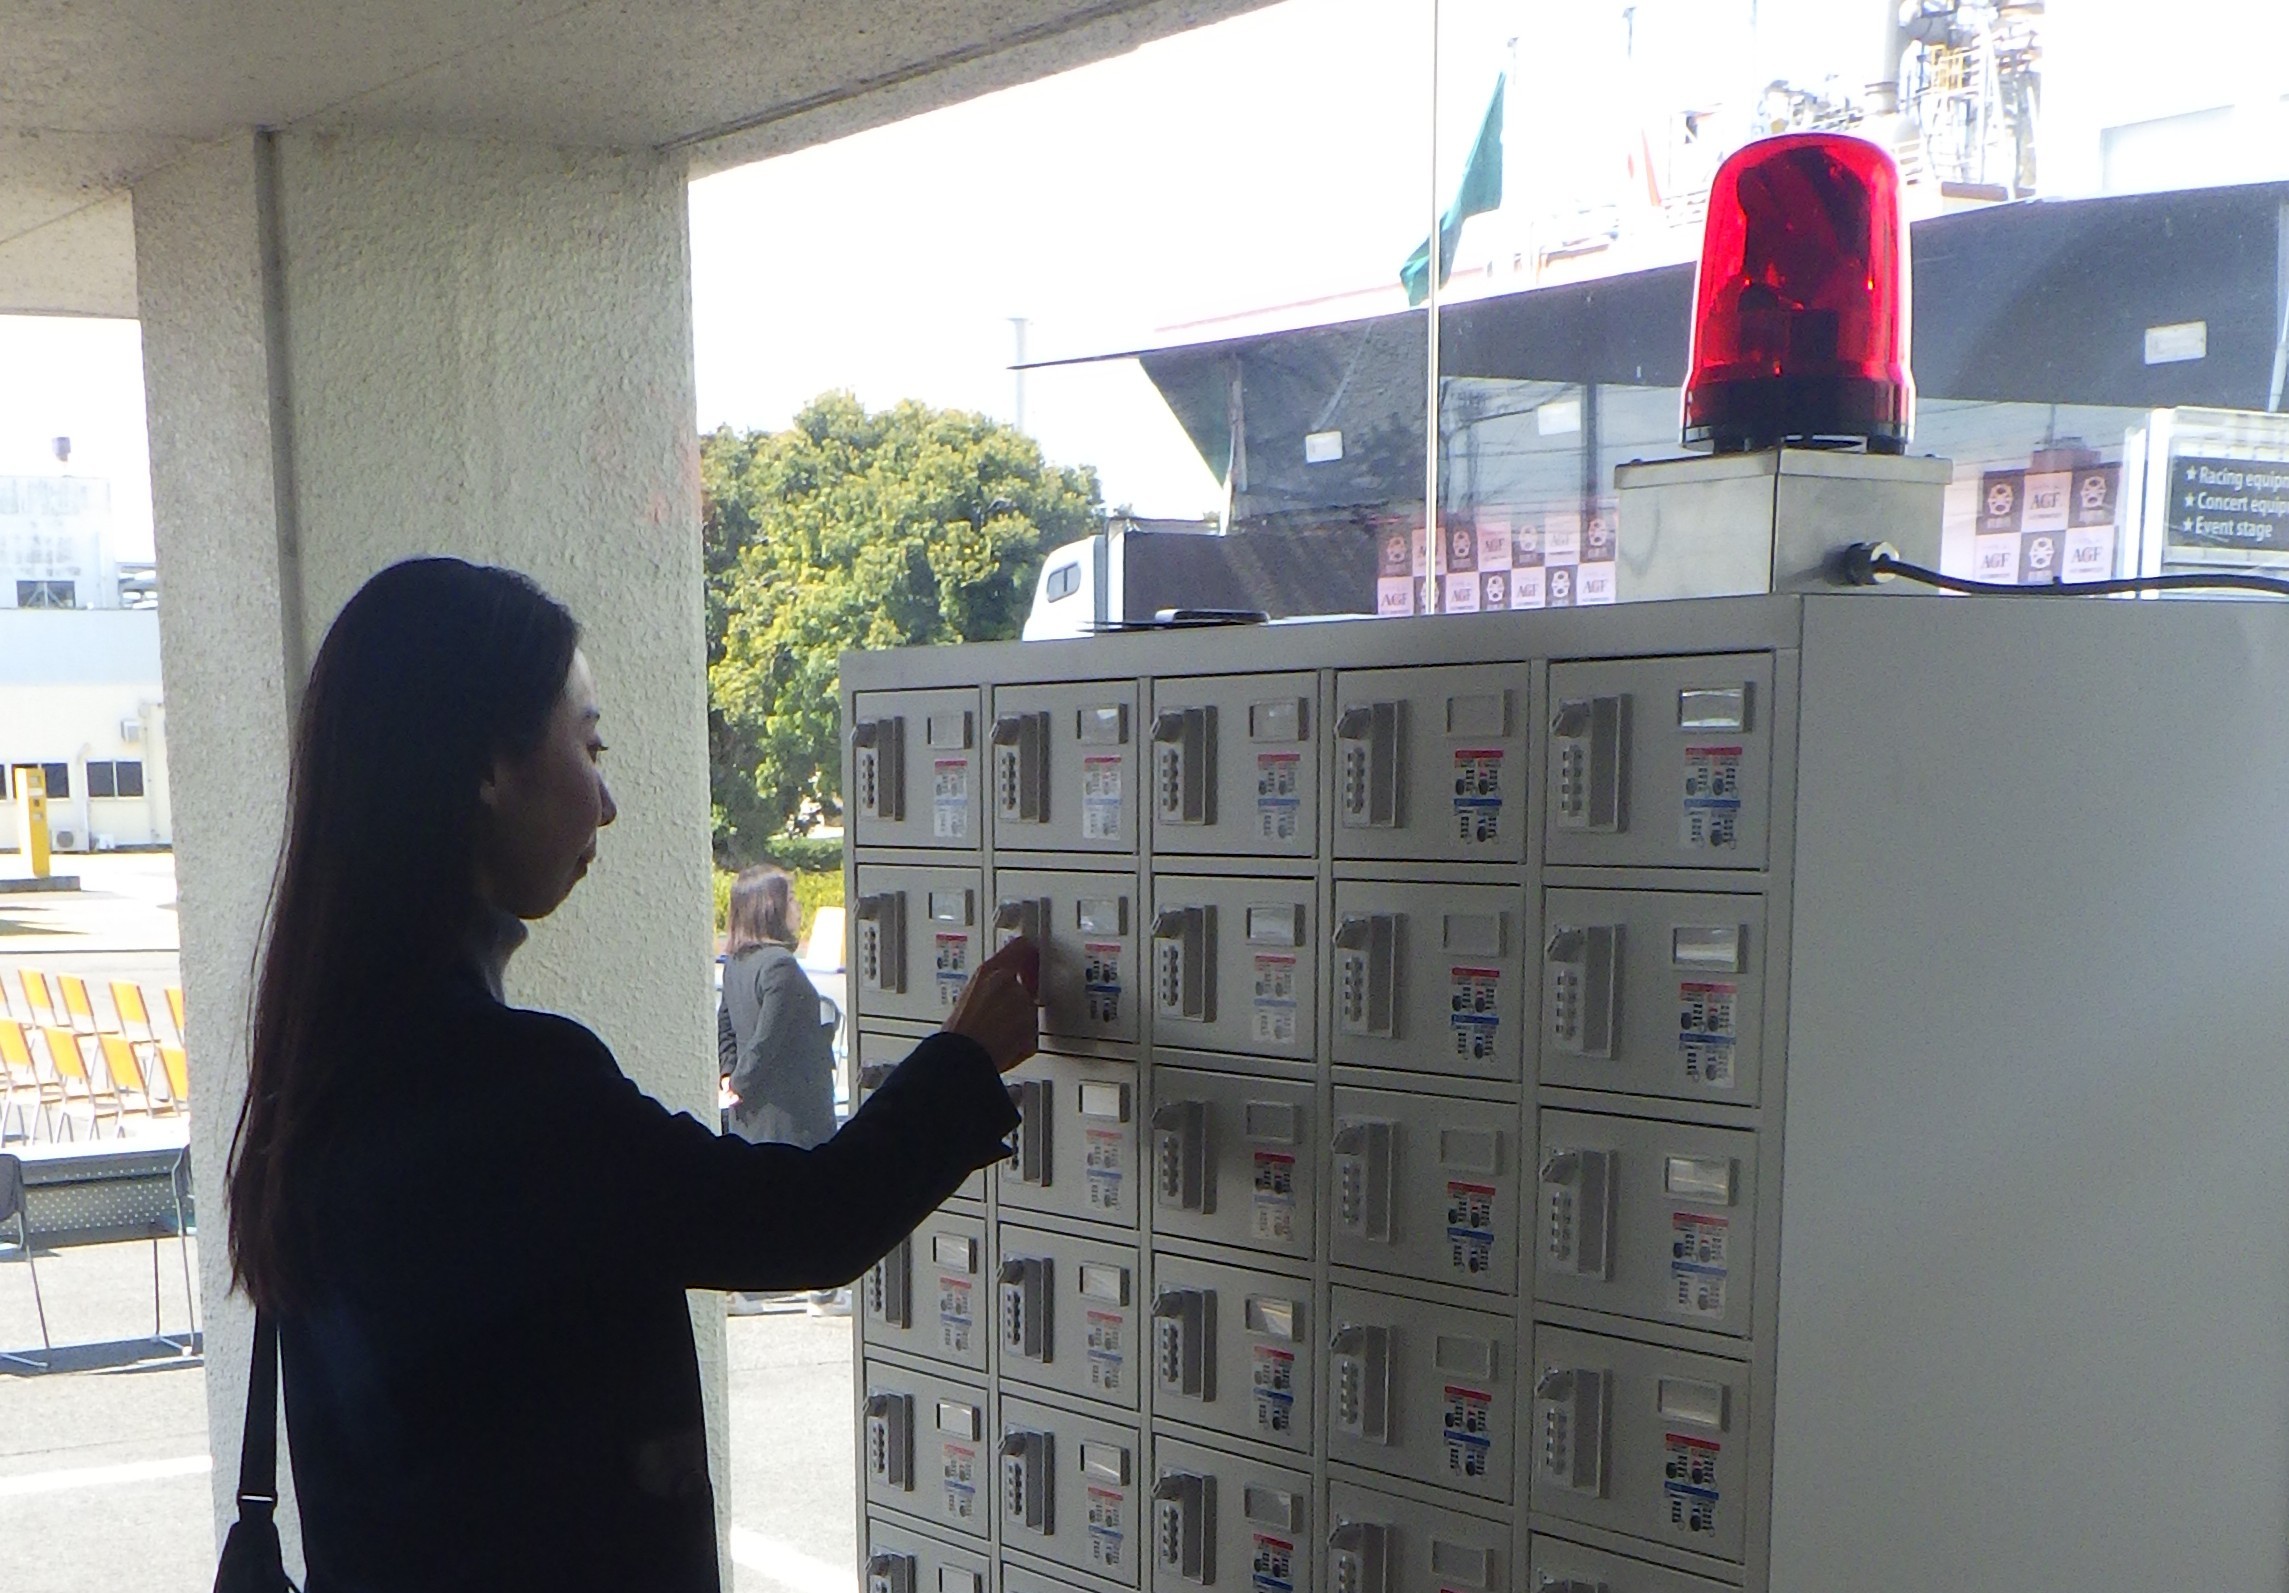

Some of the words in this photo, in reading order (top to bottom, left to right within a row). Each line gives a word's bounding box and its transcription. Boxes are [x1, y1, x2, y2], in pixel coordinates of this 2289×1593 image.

[2200, 466, 2243, 491] Racing
[2030, 492, 2061, 510] AGF
[2198, 492, 2248, 511] Concert
[2250, 496, 2289, 517] equip
[2196, 516, 2234, 535] Event
[2237, 521, 2273, 542] stage
[1981, 552, 2011, 570] AGF
[2071, 547, 2104, 563] AGF
[1583, 580, 1608, 594] AGF
[1381, 593, 1408, 606] AGF
